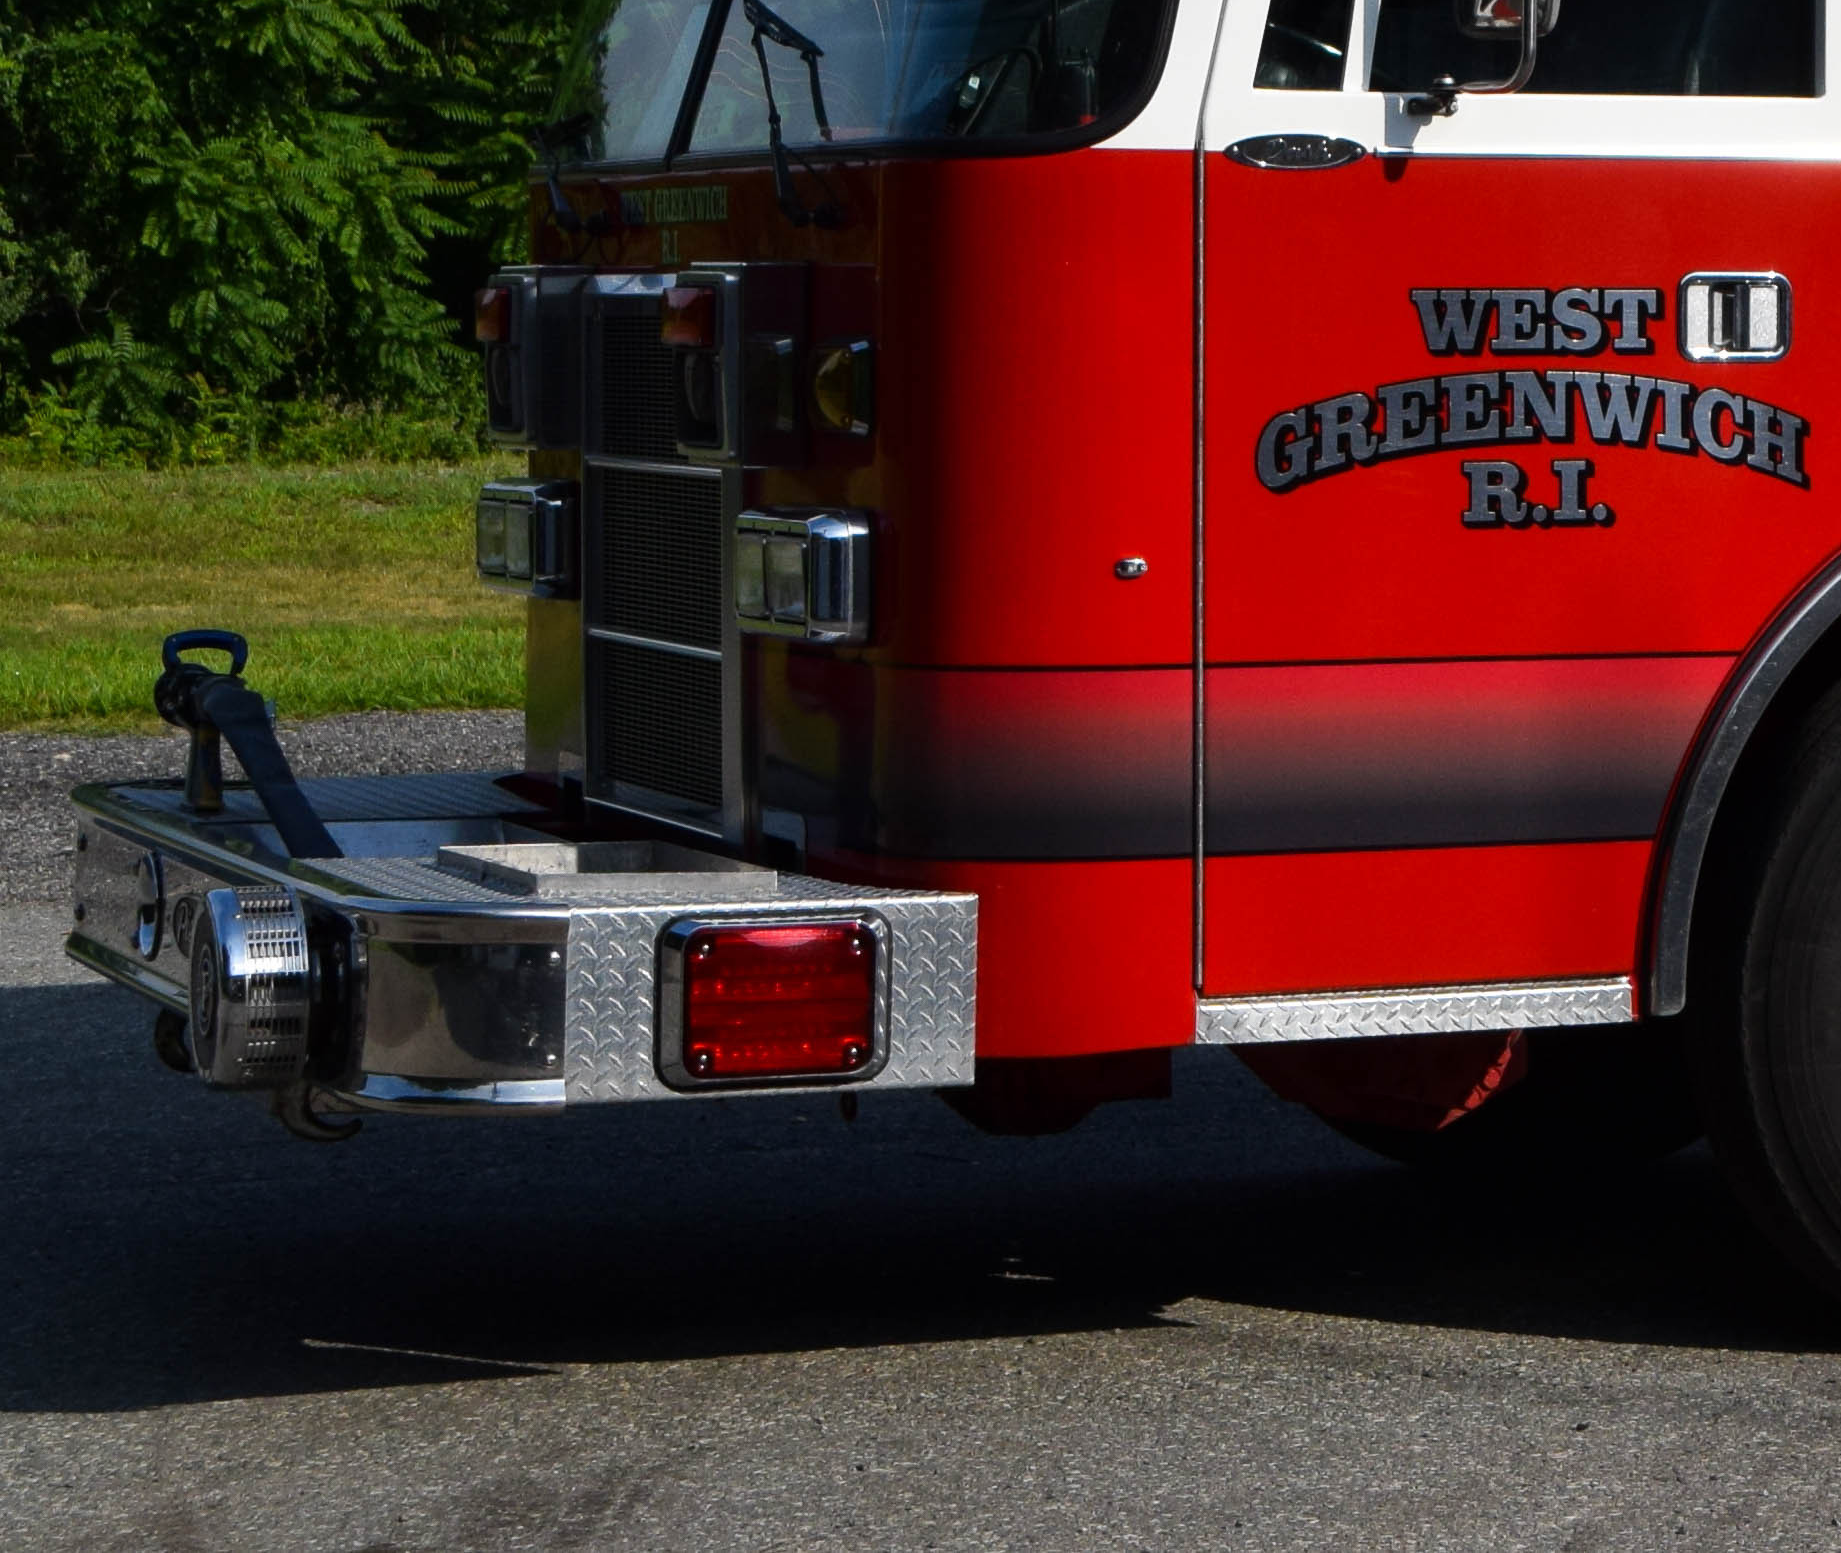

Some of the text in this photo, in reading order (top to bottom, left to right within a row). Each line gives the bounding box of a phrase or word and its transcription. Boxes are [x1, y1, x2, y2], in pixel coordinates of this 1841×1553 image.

[1410, 287, 1665, 358] WEST
[1255, 370, 1812, 493] GREENWICH
[1460, 459, 1616, 528] R.I.
